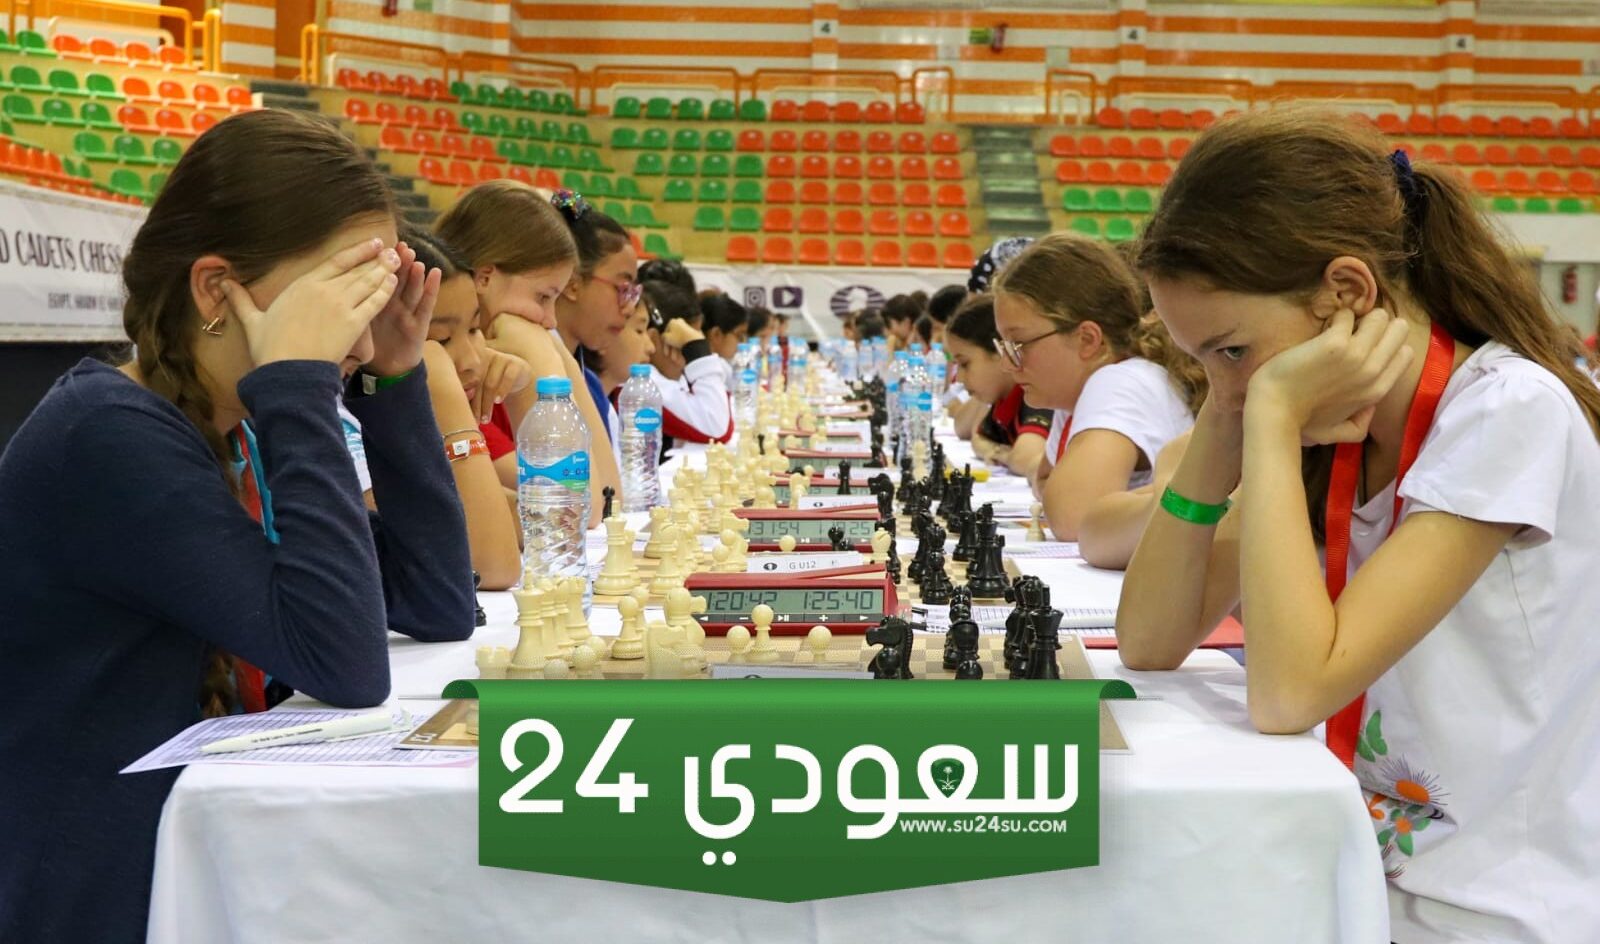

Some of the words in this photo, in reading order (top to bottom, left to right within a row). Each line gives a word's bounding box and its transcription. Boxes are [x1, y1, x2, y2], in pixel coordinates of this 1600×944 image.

[15, 230, 76, 271] CADETS
[79, 240, 123, 274] CHESS
[789, 562, 797, 570] G
[799, 560, 817, 569] U12
[708, 591, 778, 610] 1:20:42
[804, 590, 873, 610] 1:25:40
